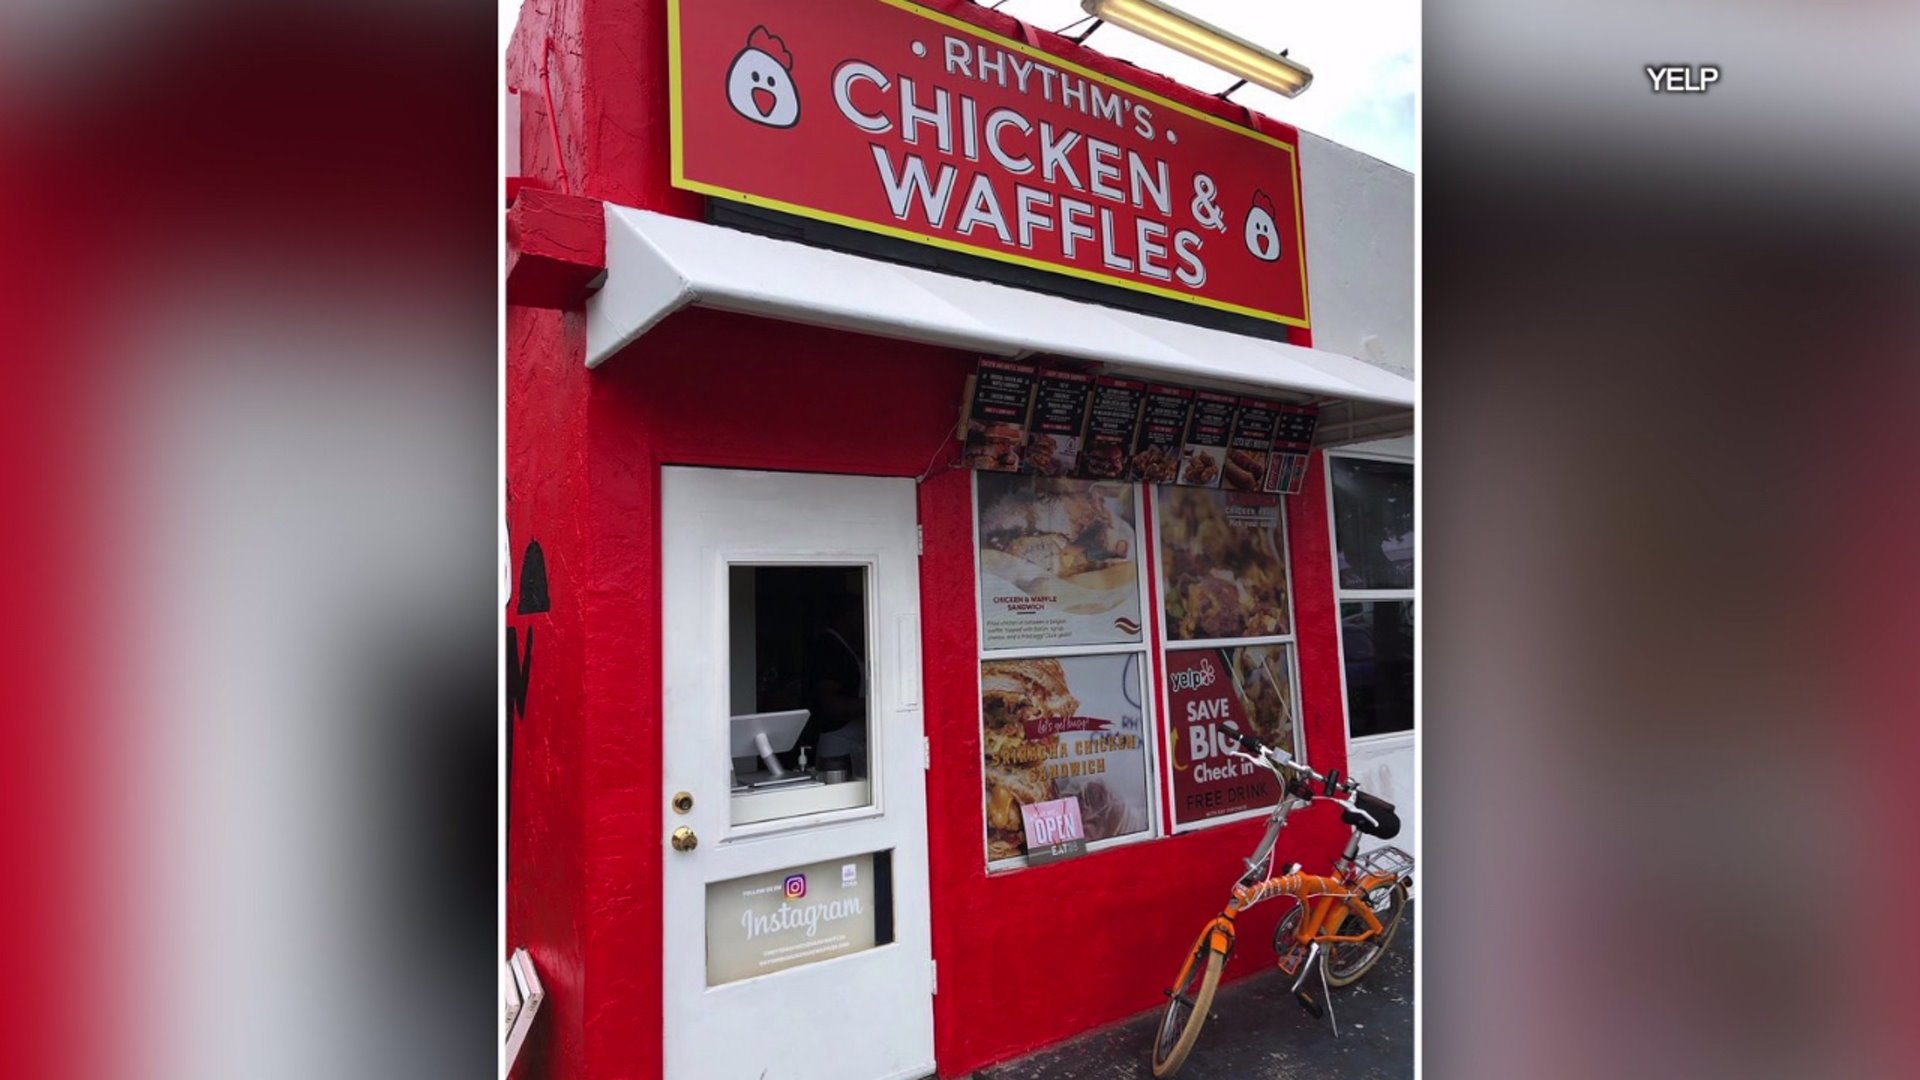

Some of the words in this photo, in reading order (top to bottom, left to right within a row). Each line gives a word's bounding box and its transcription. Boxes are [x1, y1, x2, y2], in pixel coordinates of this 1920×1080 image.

[943, 35, 1155, 141] RHYTHM'S
[831, 59, 1172, 217] CHICKEN
[1190, 171, 1228, 233] &
[870, 143, 1207, 288] WAFFLES
[993, 596, 1023, 604] CHICKEN
[1171, 667, 1201, 692] yelp
[1187, 698, 1229, 722] SAVE
[1075, 735, 1137, 756] CHICKEN
[1189, 720, 1241, 760] BIG
[1028, 758, 1106, 783] SANDWICH
[1193, 759, 1238, 783] Check
[1241, 757, 1254, 775] in
[1187, 791, 1223, 811] FREE
[1228, 783, 1268, 803] DRINK
[1034, 813, 1077, 844] OPEN
[741, 897, 863, 940] Instagram
